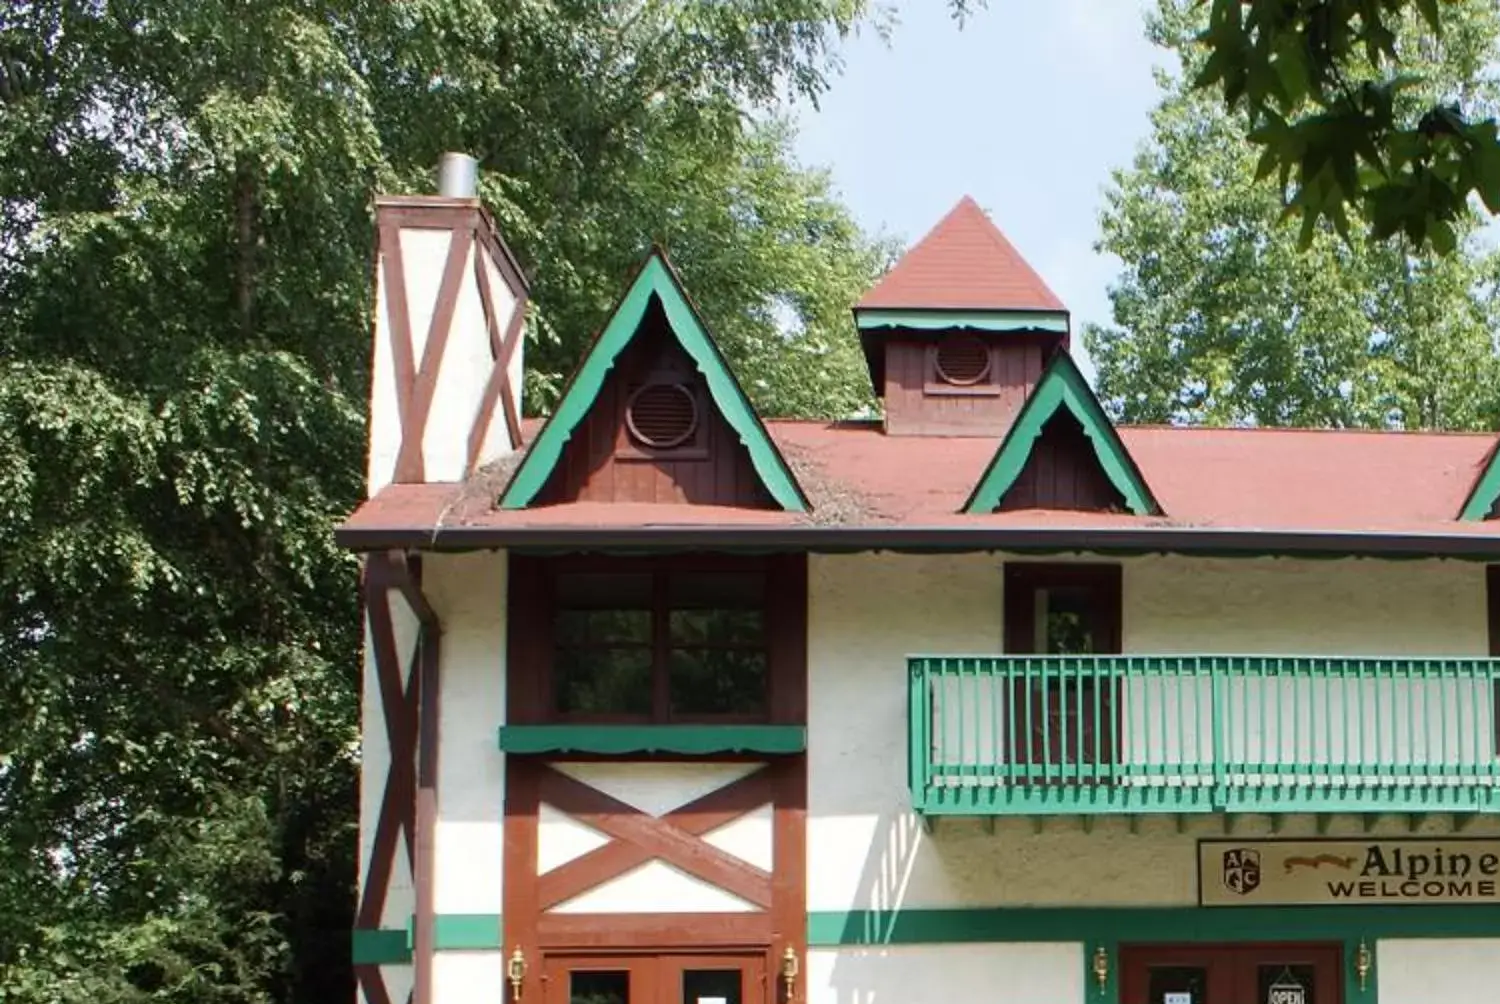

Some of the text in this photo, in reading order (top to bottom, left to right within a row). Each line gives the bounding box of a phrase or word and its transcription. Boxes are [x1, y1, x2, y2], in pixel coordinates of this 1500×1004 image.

[1228, 852, 1240, 866] A
[1360, 845, 1499, 879] Alpine
[1244, 871, 1256, 886] C
[1328, 880, 1496, 897] WELCOME
